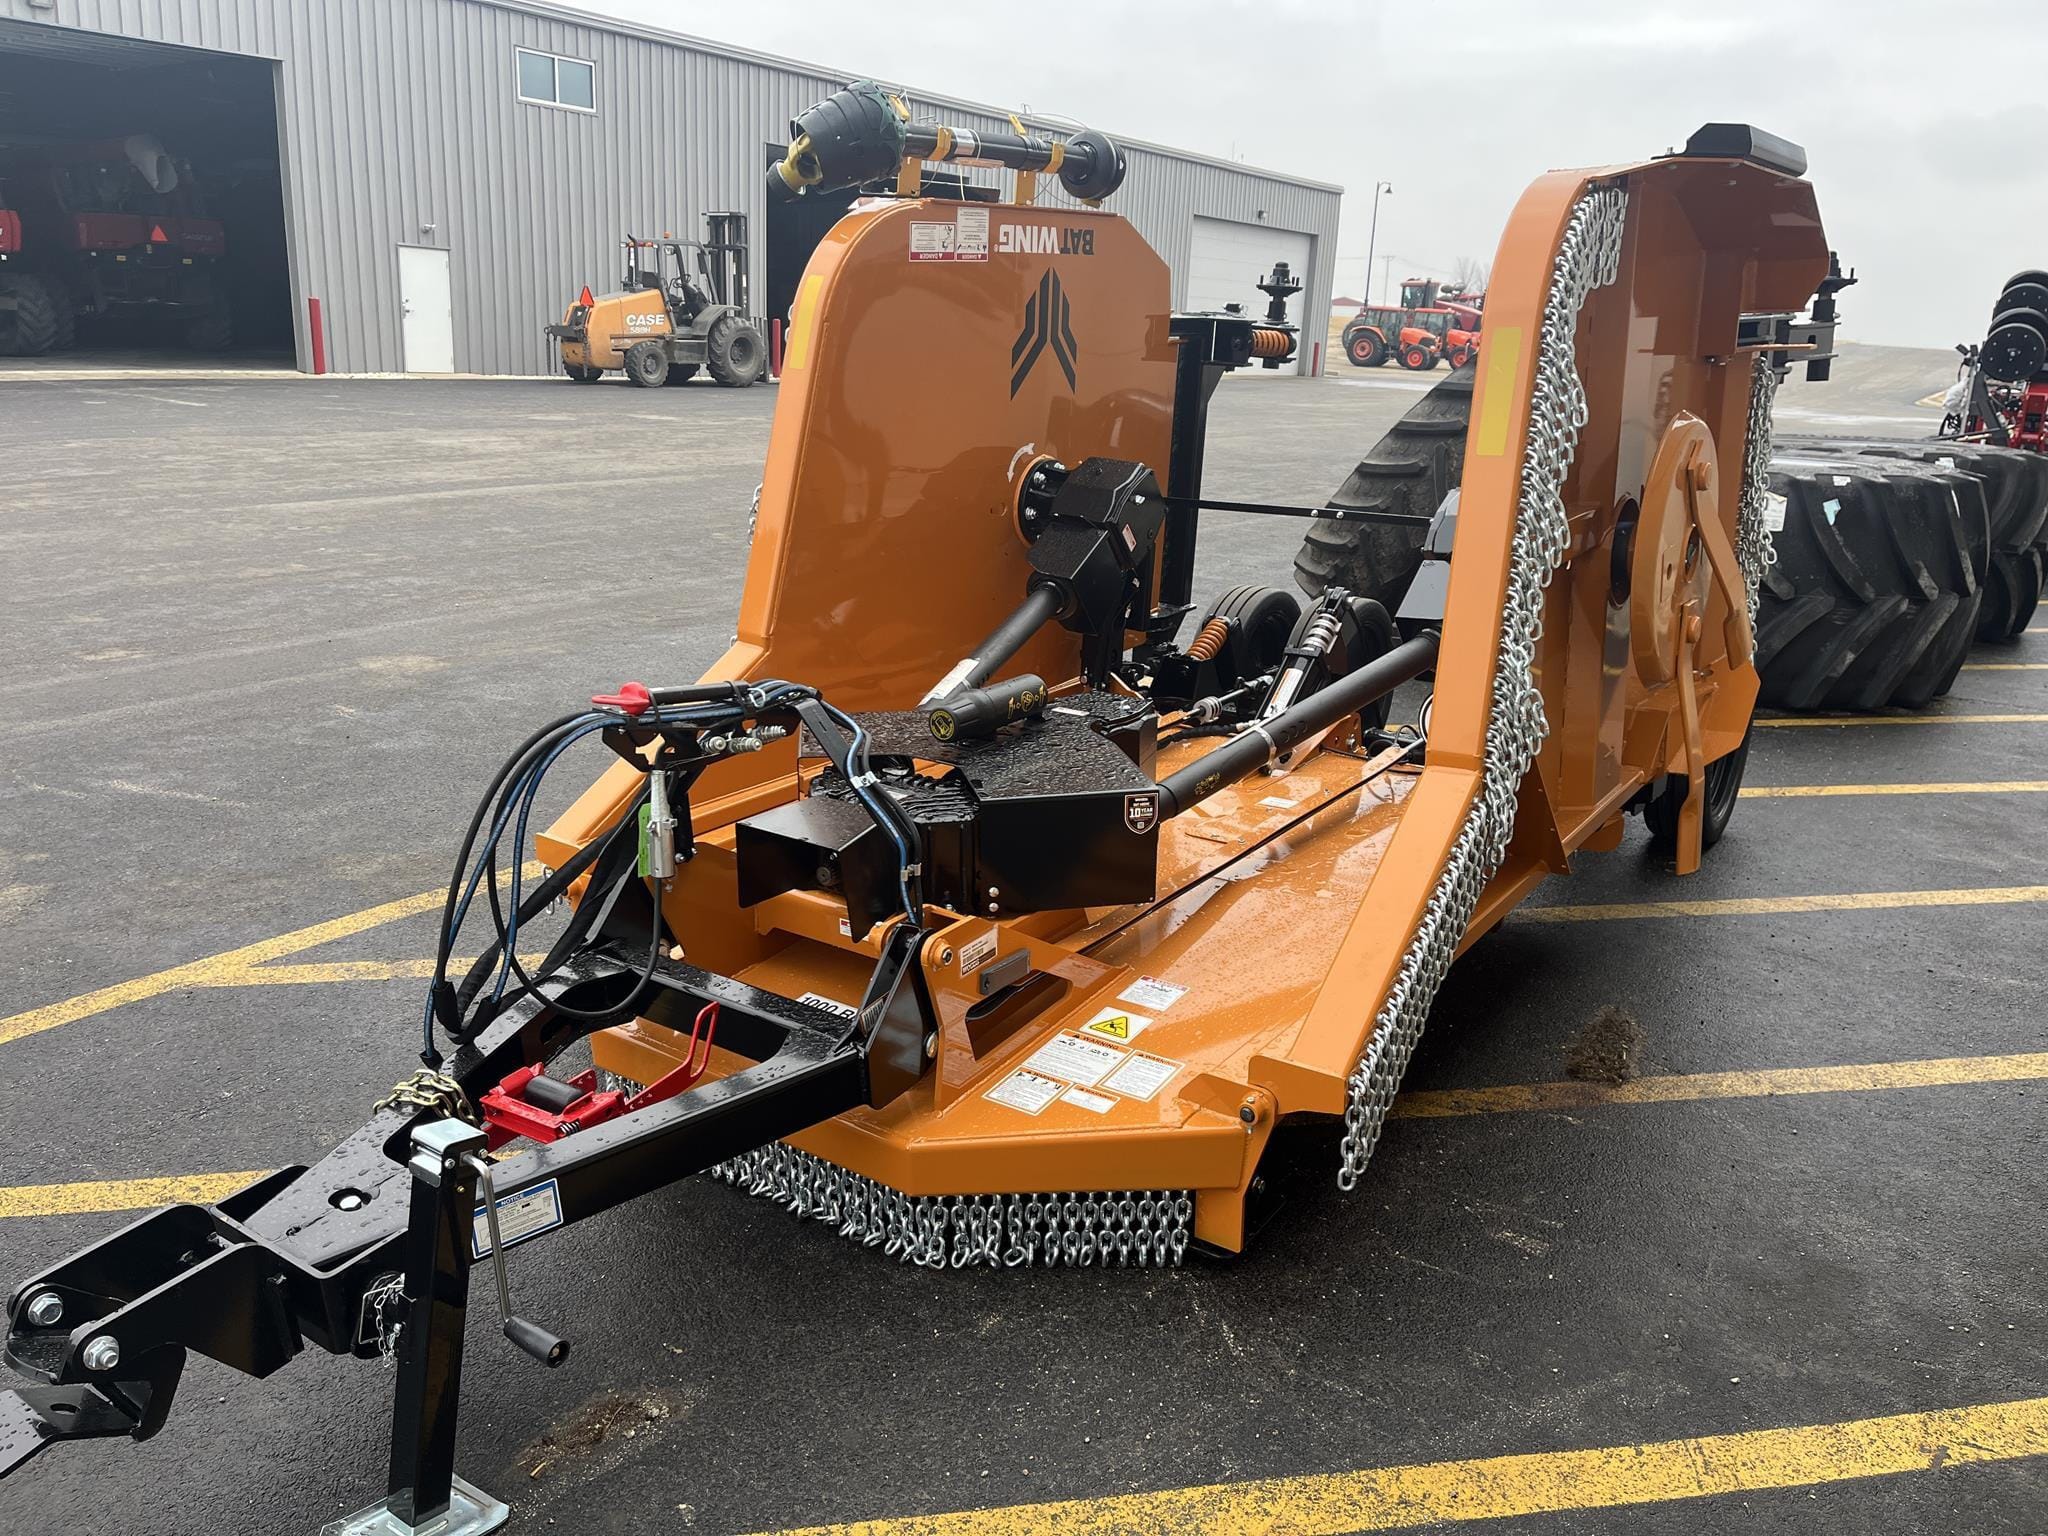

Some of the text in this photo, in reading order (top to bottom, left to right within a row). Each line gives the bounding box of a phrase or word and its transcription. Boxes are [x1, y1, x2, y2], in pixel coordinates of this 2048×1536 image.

[626, 314, 665, 326] CASE
[1082, 1035, 1120, 1051] WARNING
[501, 1192, 524, 1206] NOTICE
